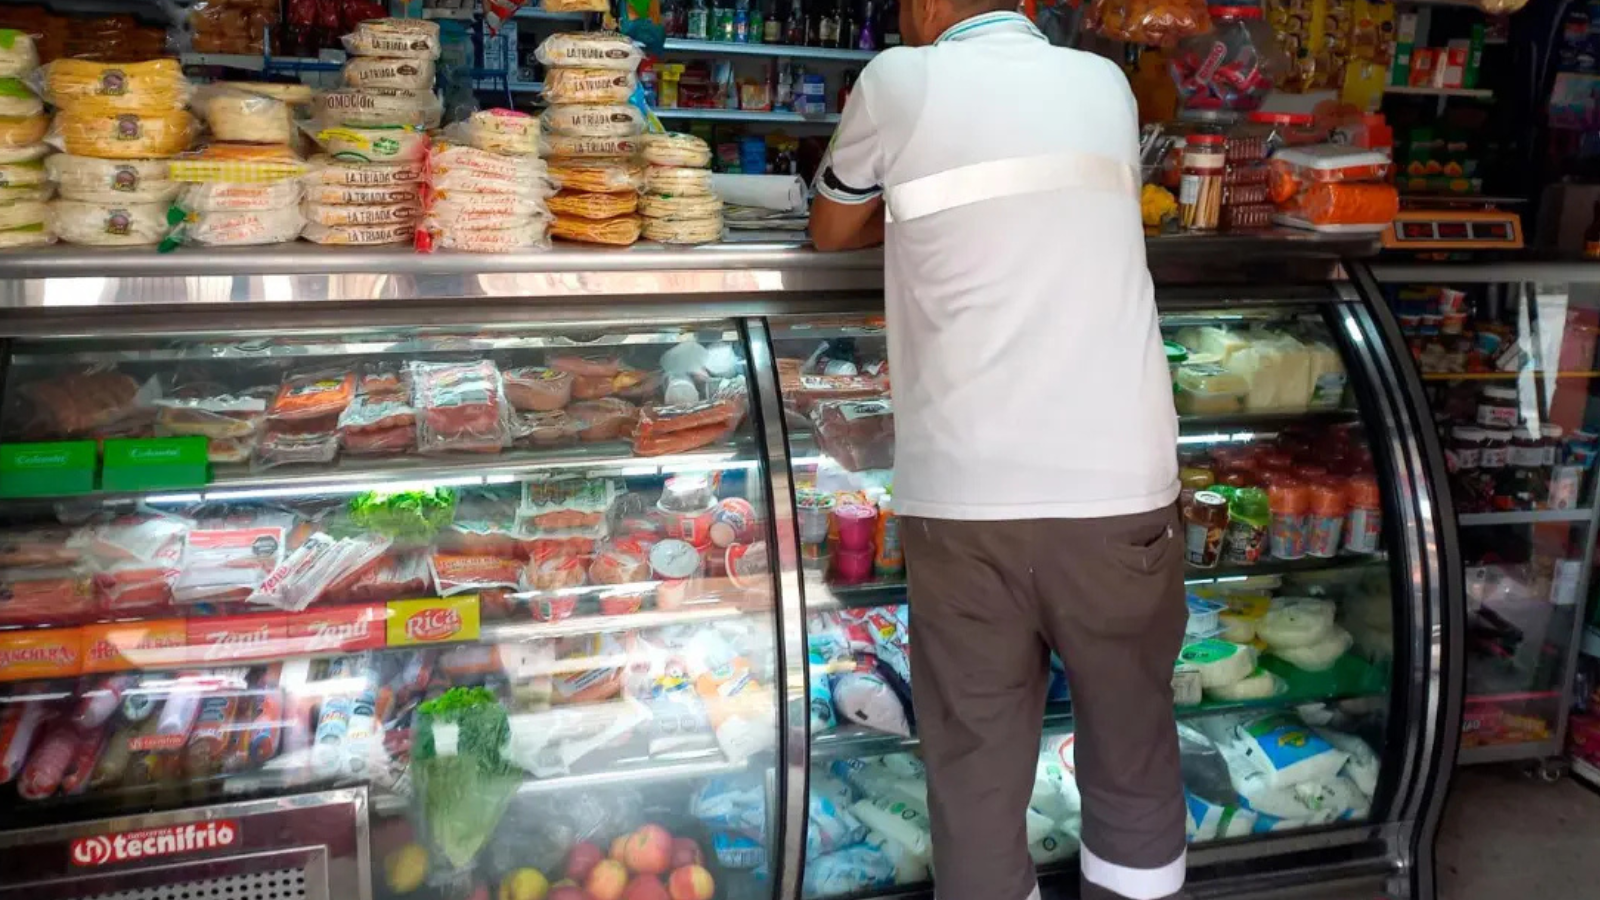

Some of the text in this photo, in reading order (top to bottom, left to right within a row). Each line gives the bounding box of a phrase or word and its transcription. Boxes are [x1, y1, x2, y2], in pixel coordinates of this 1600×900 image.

[345, 171, 355, 183] LA
[359, 171, 391, 184] TRIADA
[347, 209, 391, 223] LA TRIADA
[348, 229, 392, 242] LA TRIADA
[408, 609, 457, 638] Rica
[113, 822, 234, 859] tecnifrio
